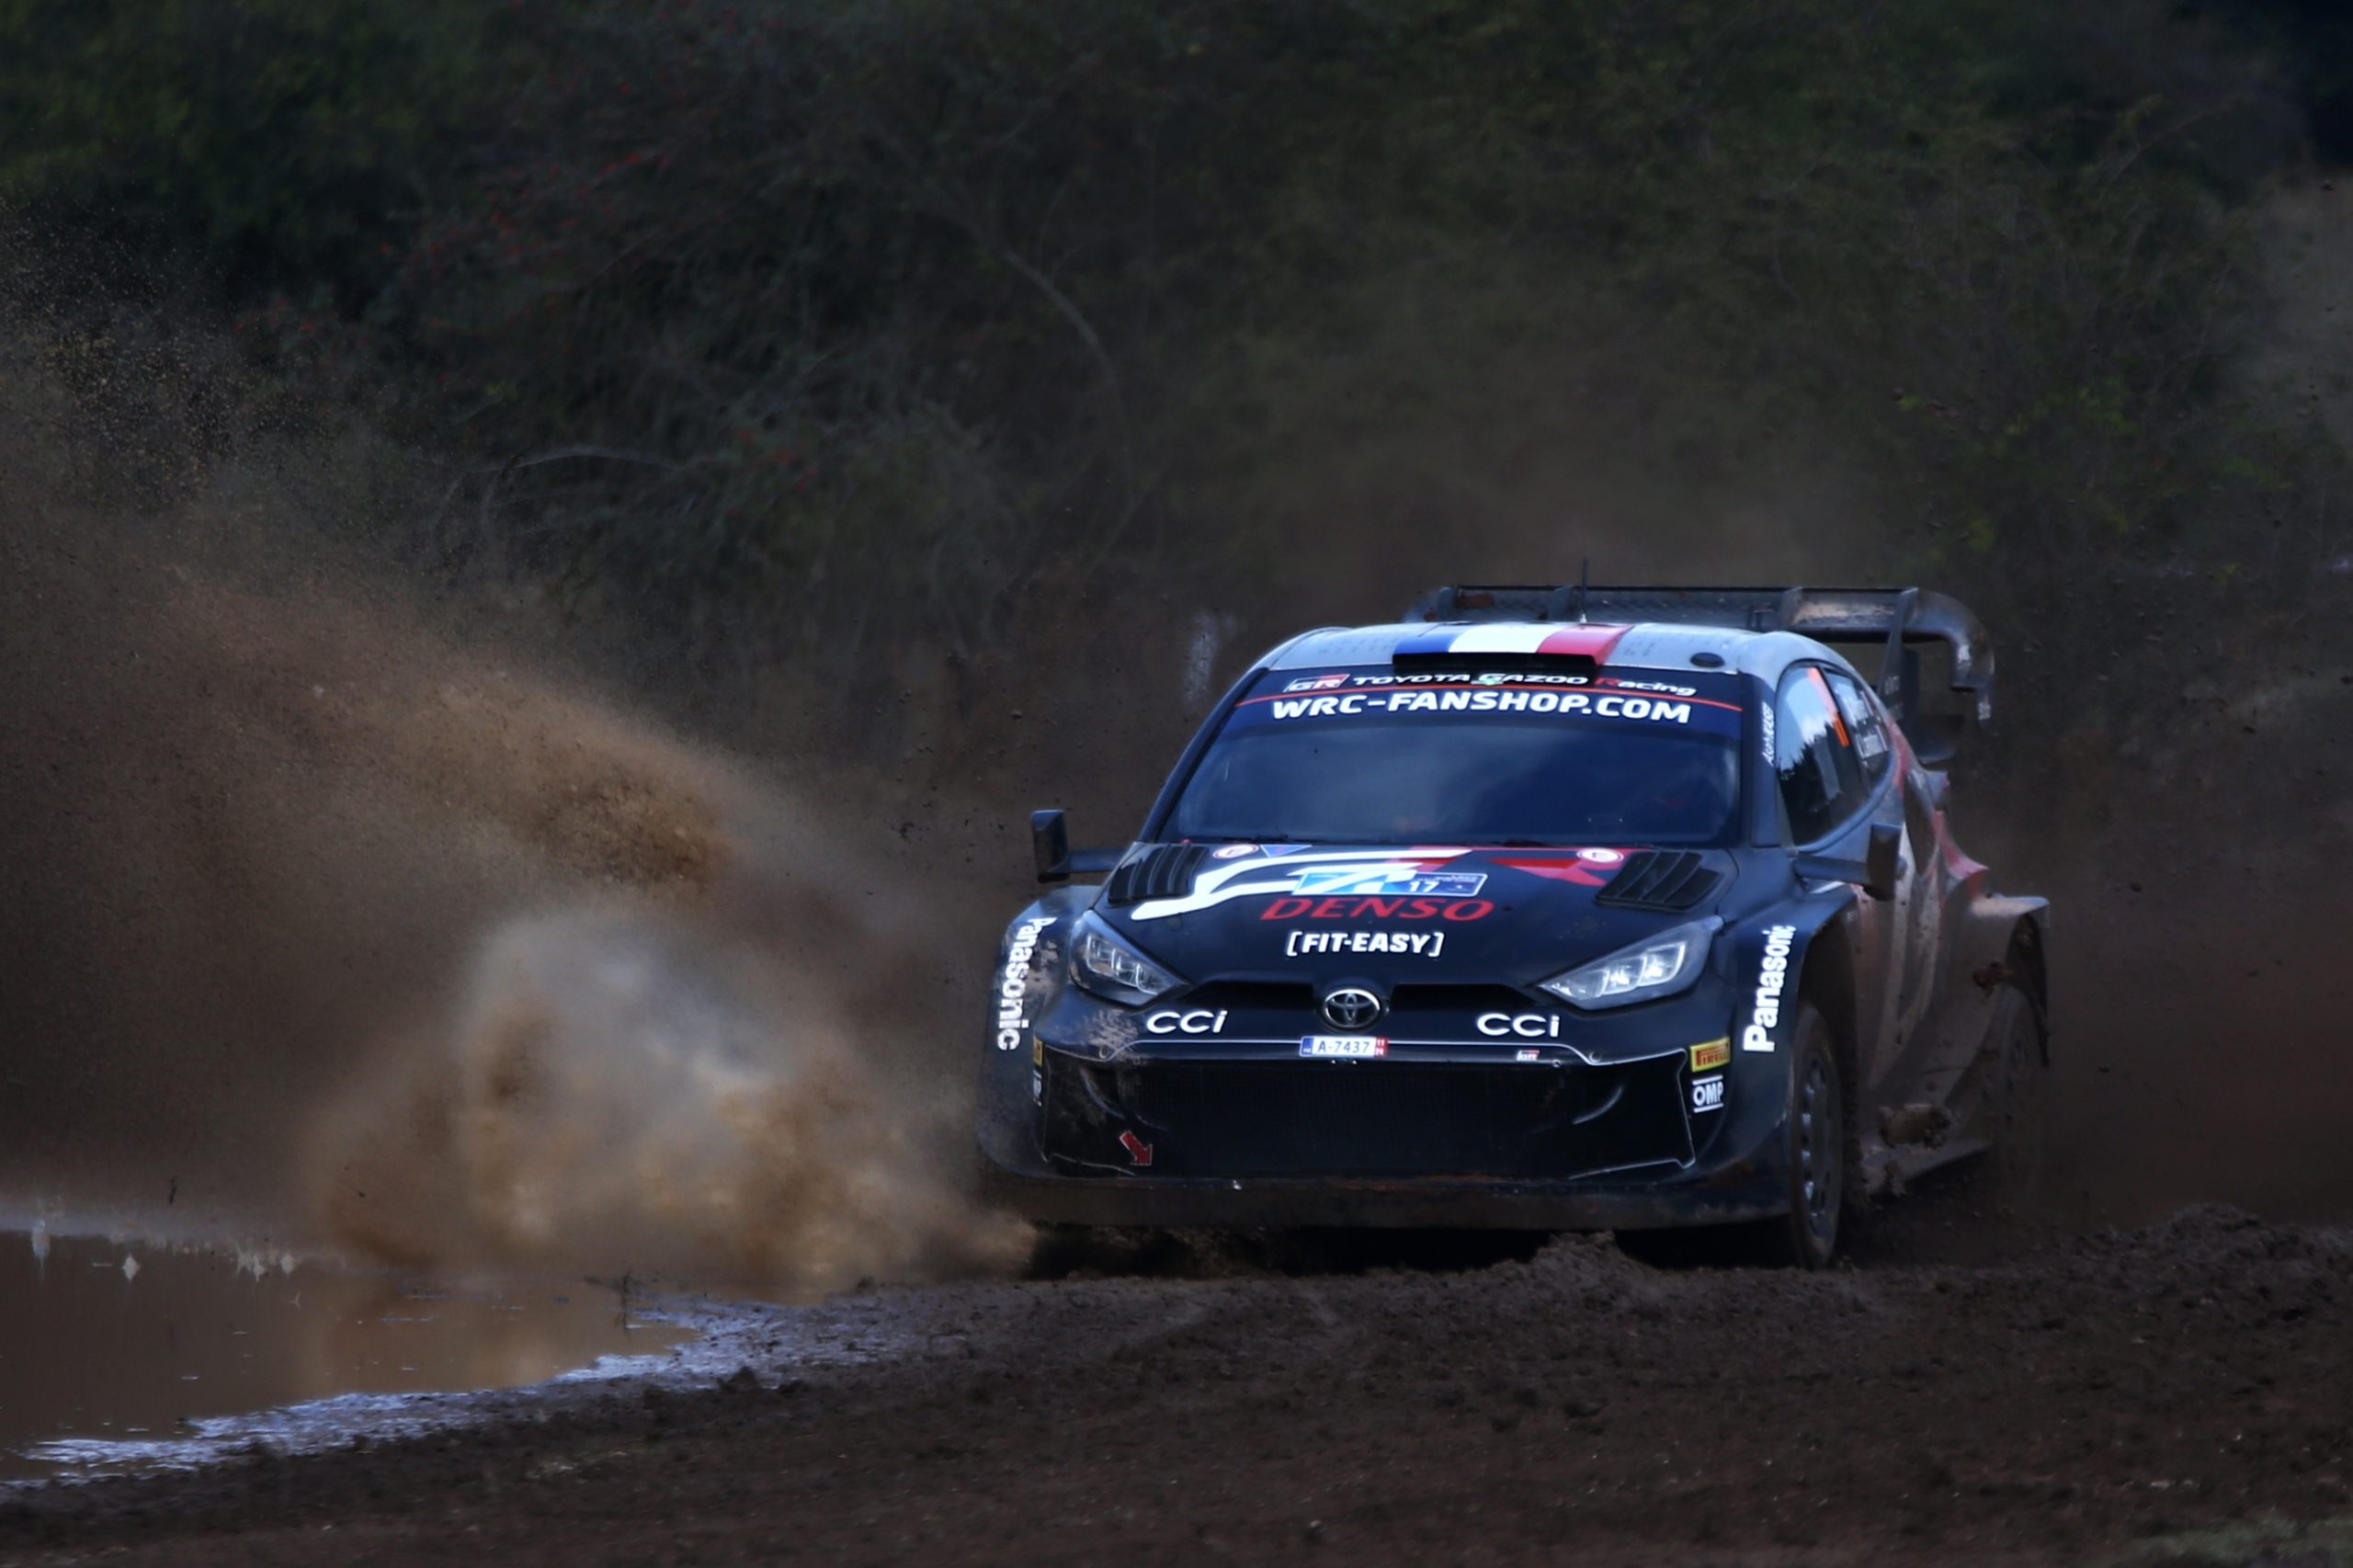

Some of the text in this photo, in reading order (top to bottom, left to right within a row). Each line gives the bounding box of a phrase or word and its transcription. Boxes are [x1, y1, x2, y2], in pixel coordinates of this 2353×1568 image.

[1352, 674, 1471, 686] TOYOTA
[1472, 673, 1589, 687] GAZOO
[1594, 676, 1698, 697] Racing
[1273, 691, 1691, 723] WRC-FANSHOP.COM
[1409, 881, 1440, 892] 17
[1260, 897, 1495, 921] DENSO
[997, 917, 1058, 1051] Panasonic
[1743, 925, 1796, 1052] Panasonic
[1317, 1037, 1370, 1054] A-7437
[1693, 1081, 1723, 1107] OMP
